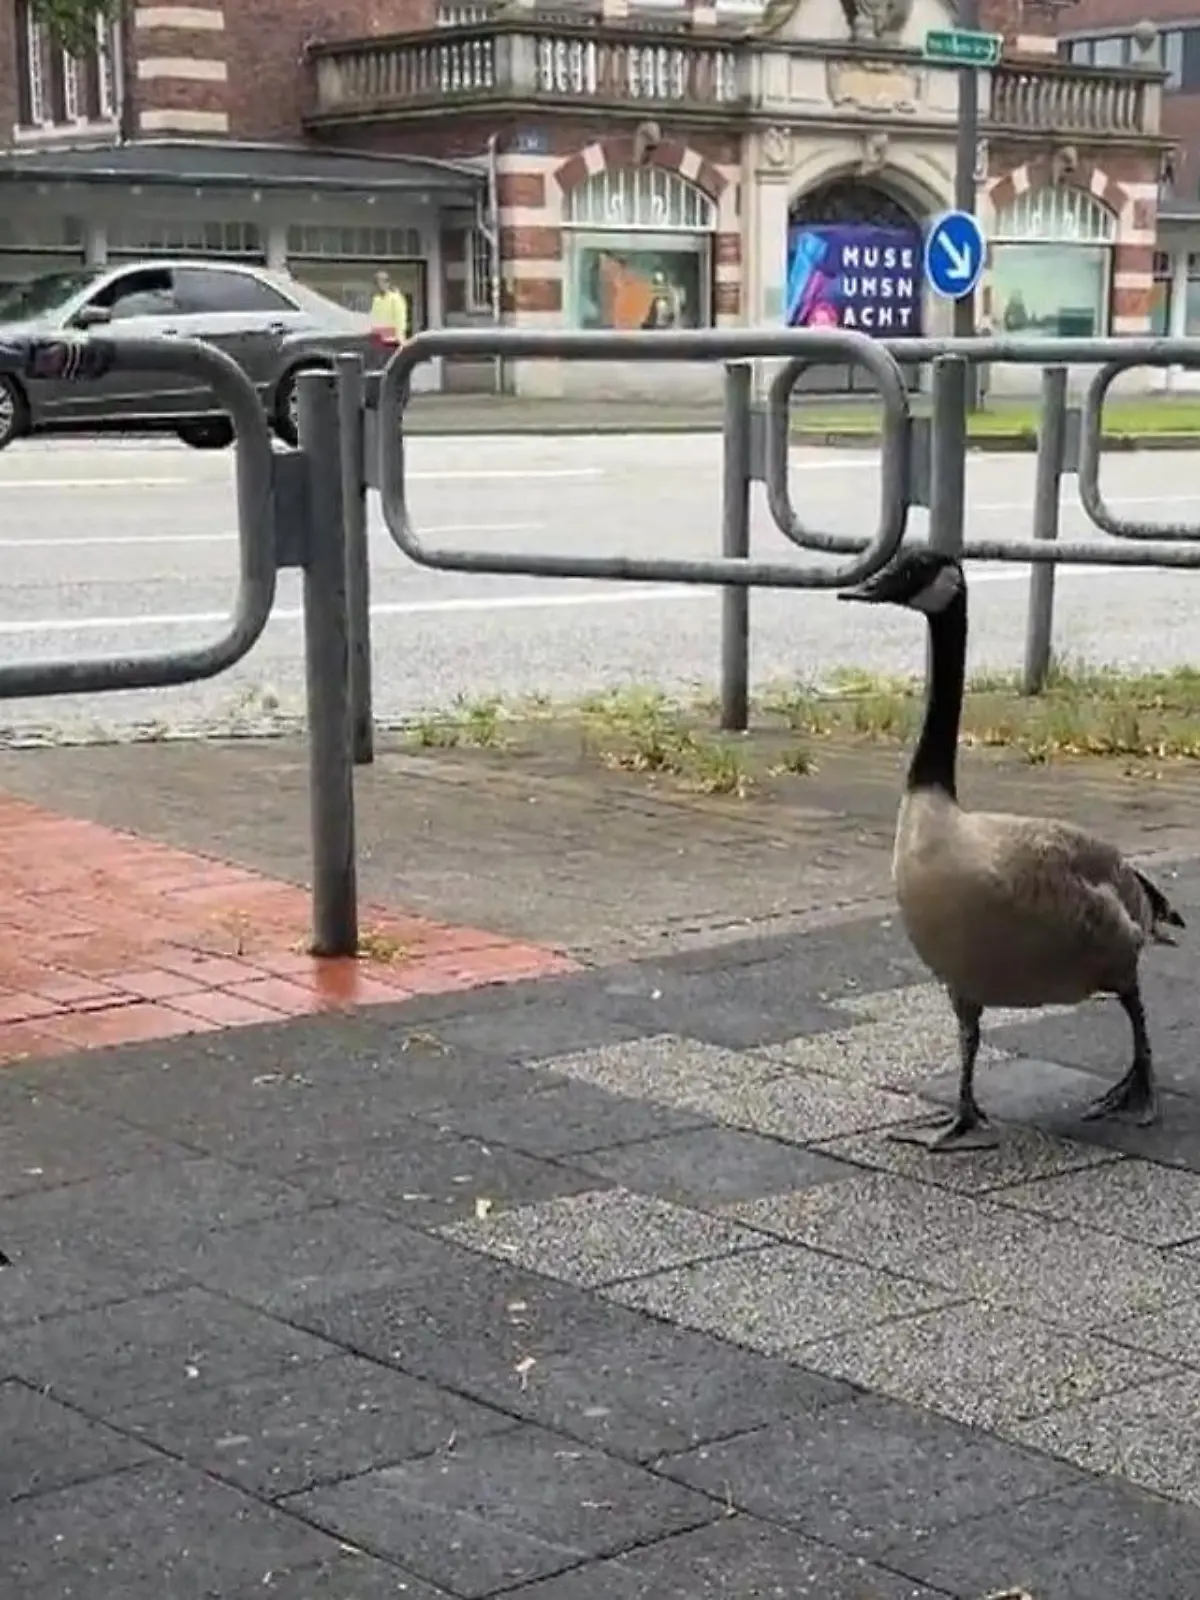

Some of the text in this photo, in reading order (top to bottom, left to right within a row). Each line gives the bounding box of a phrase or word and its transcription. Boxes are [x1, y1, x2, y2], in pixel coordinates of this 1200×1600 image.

[842, 245, 913, 269] MUSE
[842, 277, 913, 298] UMSN
[843, 307, 912, 327] ACHT
